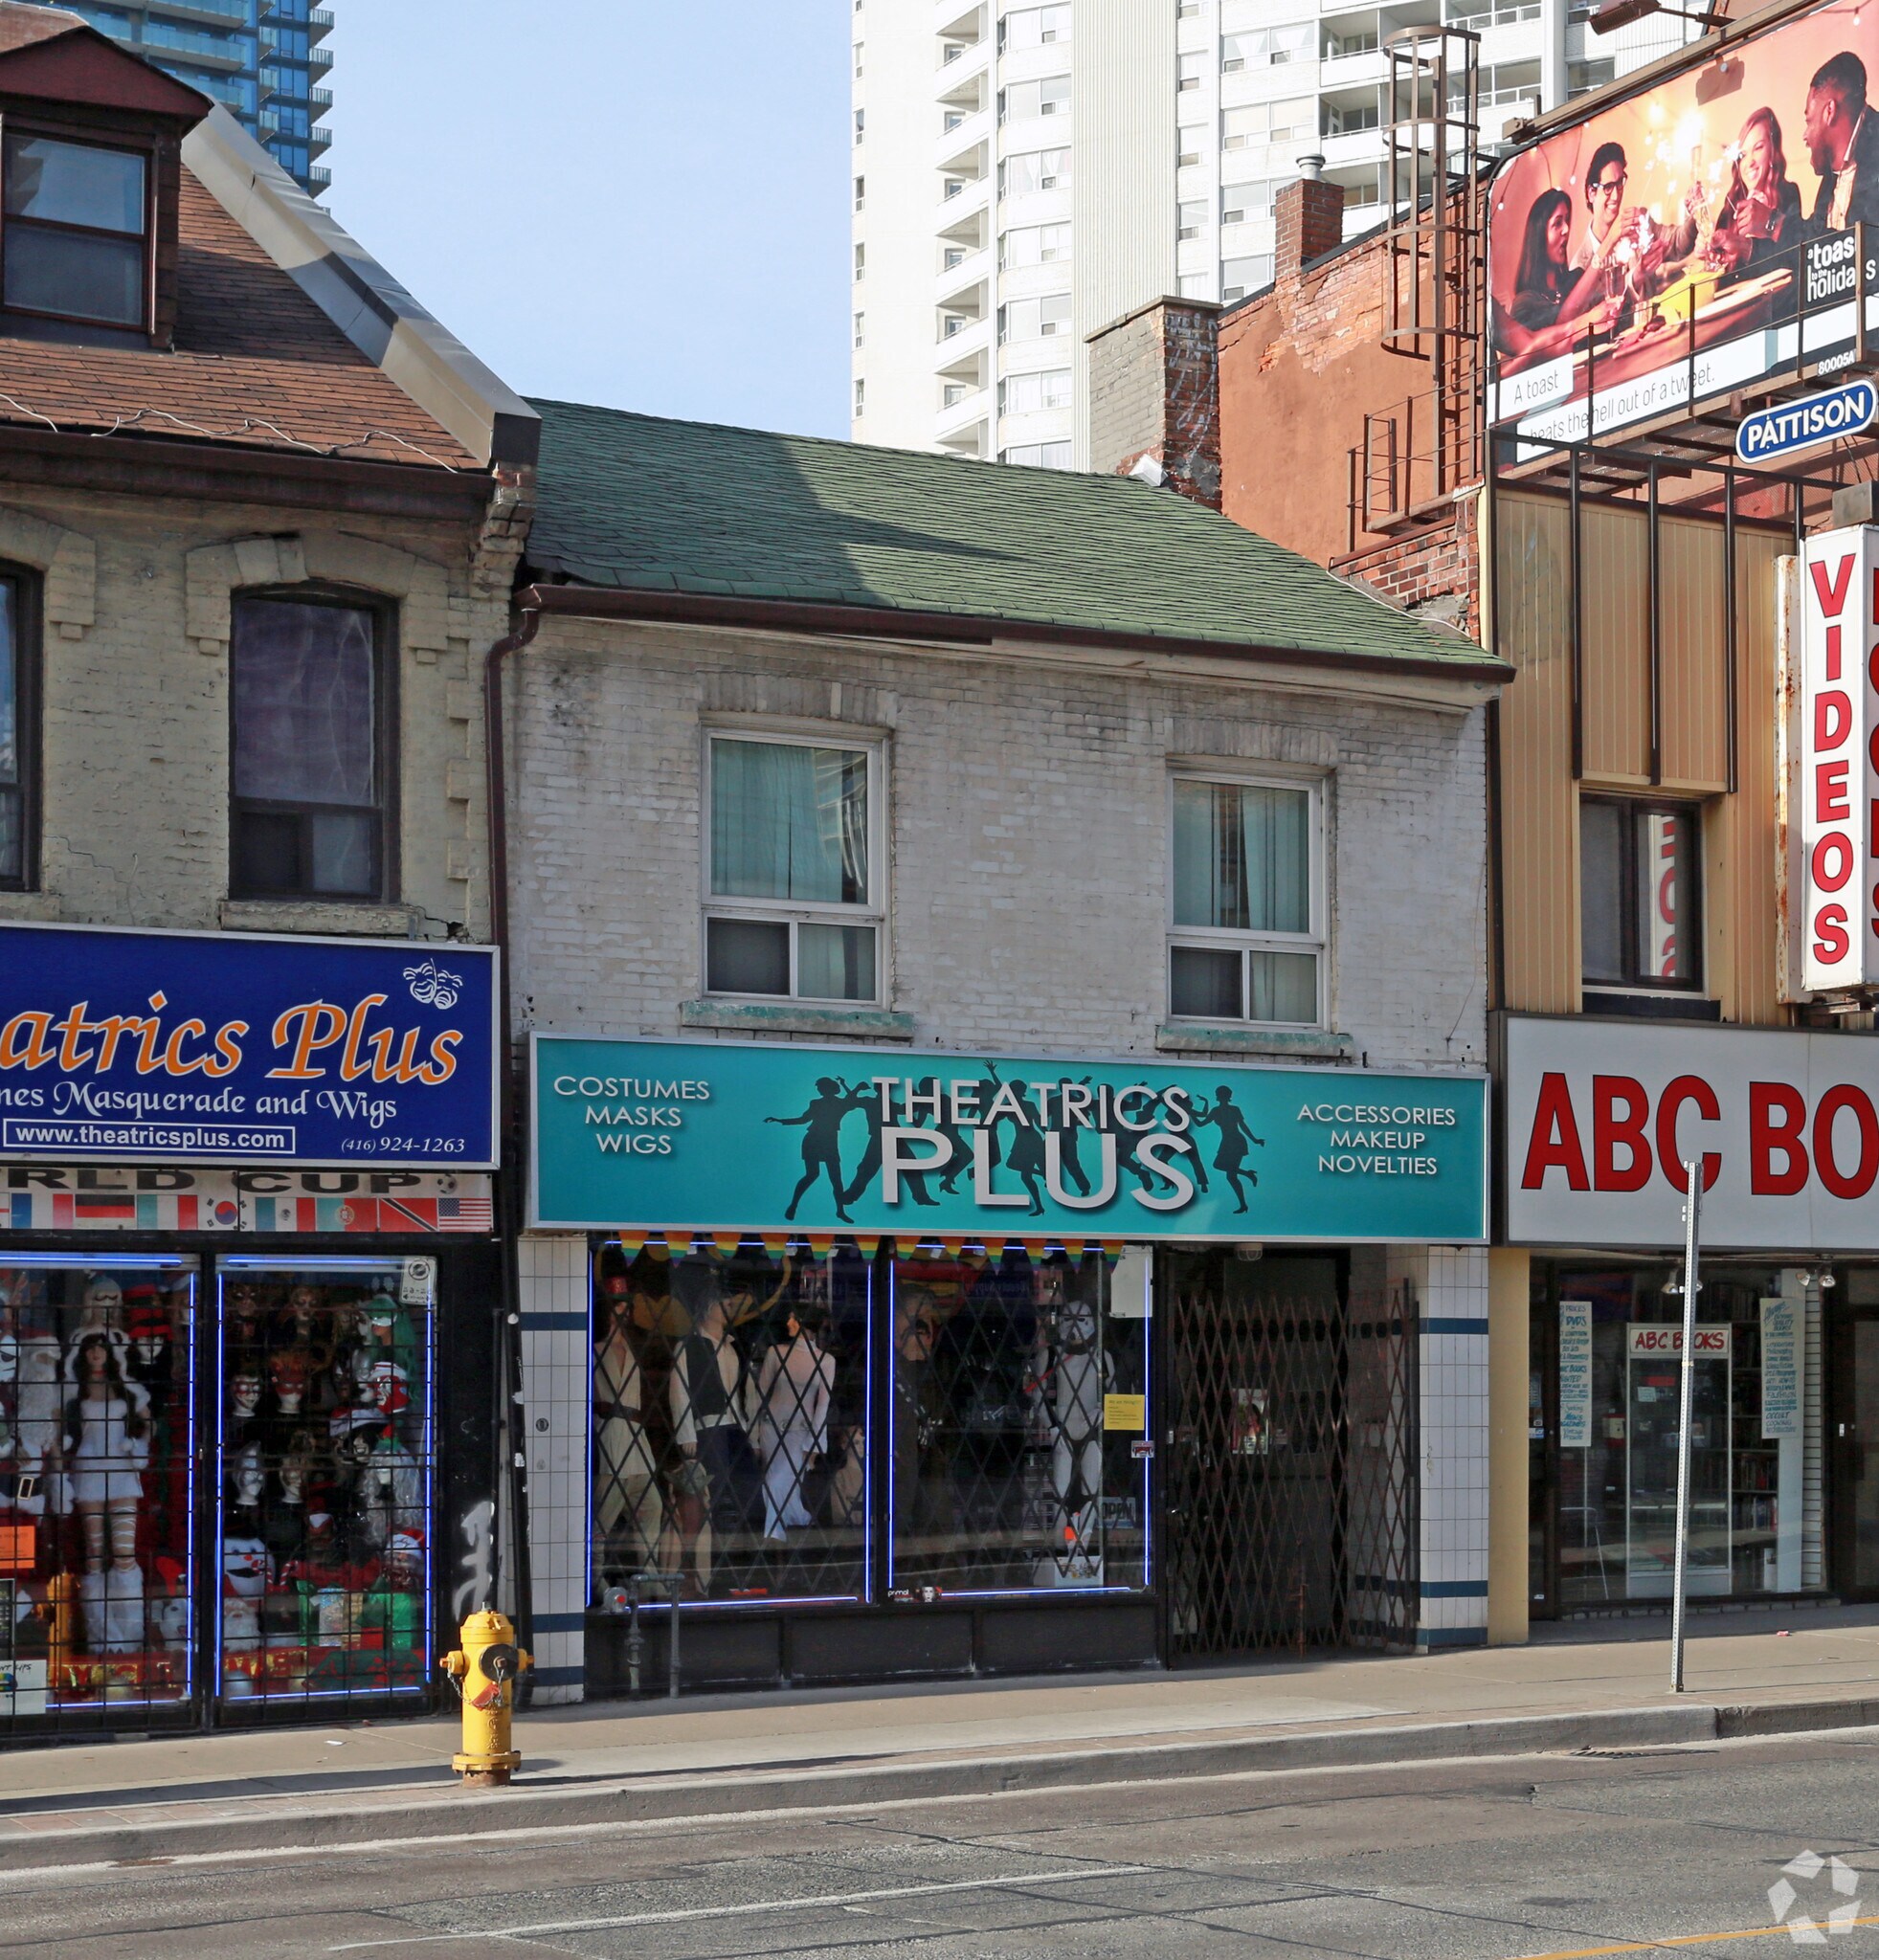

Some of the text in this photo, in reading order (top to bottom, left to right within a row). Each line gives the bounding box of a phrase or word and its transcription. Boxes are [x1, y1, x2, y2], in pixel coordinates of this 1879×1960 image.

[1807, 235, 1854, 270] a toas
[1807, 258, 1876, 302] holidas
[1819, 351, 1856, 375] 80005A
[1514, 369, 1558, 405] A toast
[1568, 412, 1590, 433] the
[1618, 390, 1639, 415] out
[1643, 382, 1656, 406] of
[1659, 383, 1667, 400] a
[1748, 391, 1866, 452] PATTISON
[1809, 553, 1856, 965] VIDEOS
[265, 992, 464, 1085] Plus
[553, 1075, 710, 1100] COSTUMES
[53, 1080, 246, 1120] Masquerade
[256, 1089, 311, 1115] and
[316, 1090, 397, 1129] Wigs
[585, 1105, 682, 1127] MASKS
[871, 1075, 1191, 1133] THEATRICS
[1297, 1102, 1456, 1126] ACCESSORIES
[15, 1125, 285, 1149] www.theatricsplus.com
[341, 1135, 465, 1153] (416) 924-1263
[595, 1133, 673, 1155] WIGS
[1330, 1130, 1426, 1150] MAKEUP
[1521, 1071, 1879, 1200] ABC BO
[8, 1167, 423, 1194] RLD CUP
[881, 1125, 1197, 1211] PLUS
[1318, 1154, 1438, 1176] NOVELTIES
[1636, 1330, 1725, 1350] ABC BOKS
